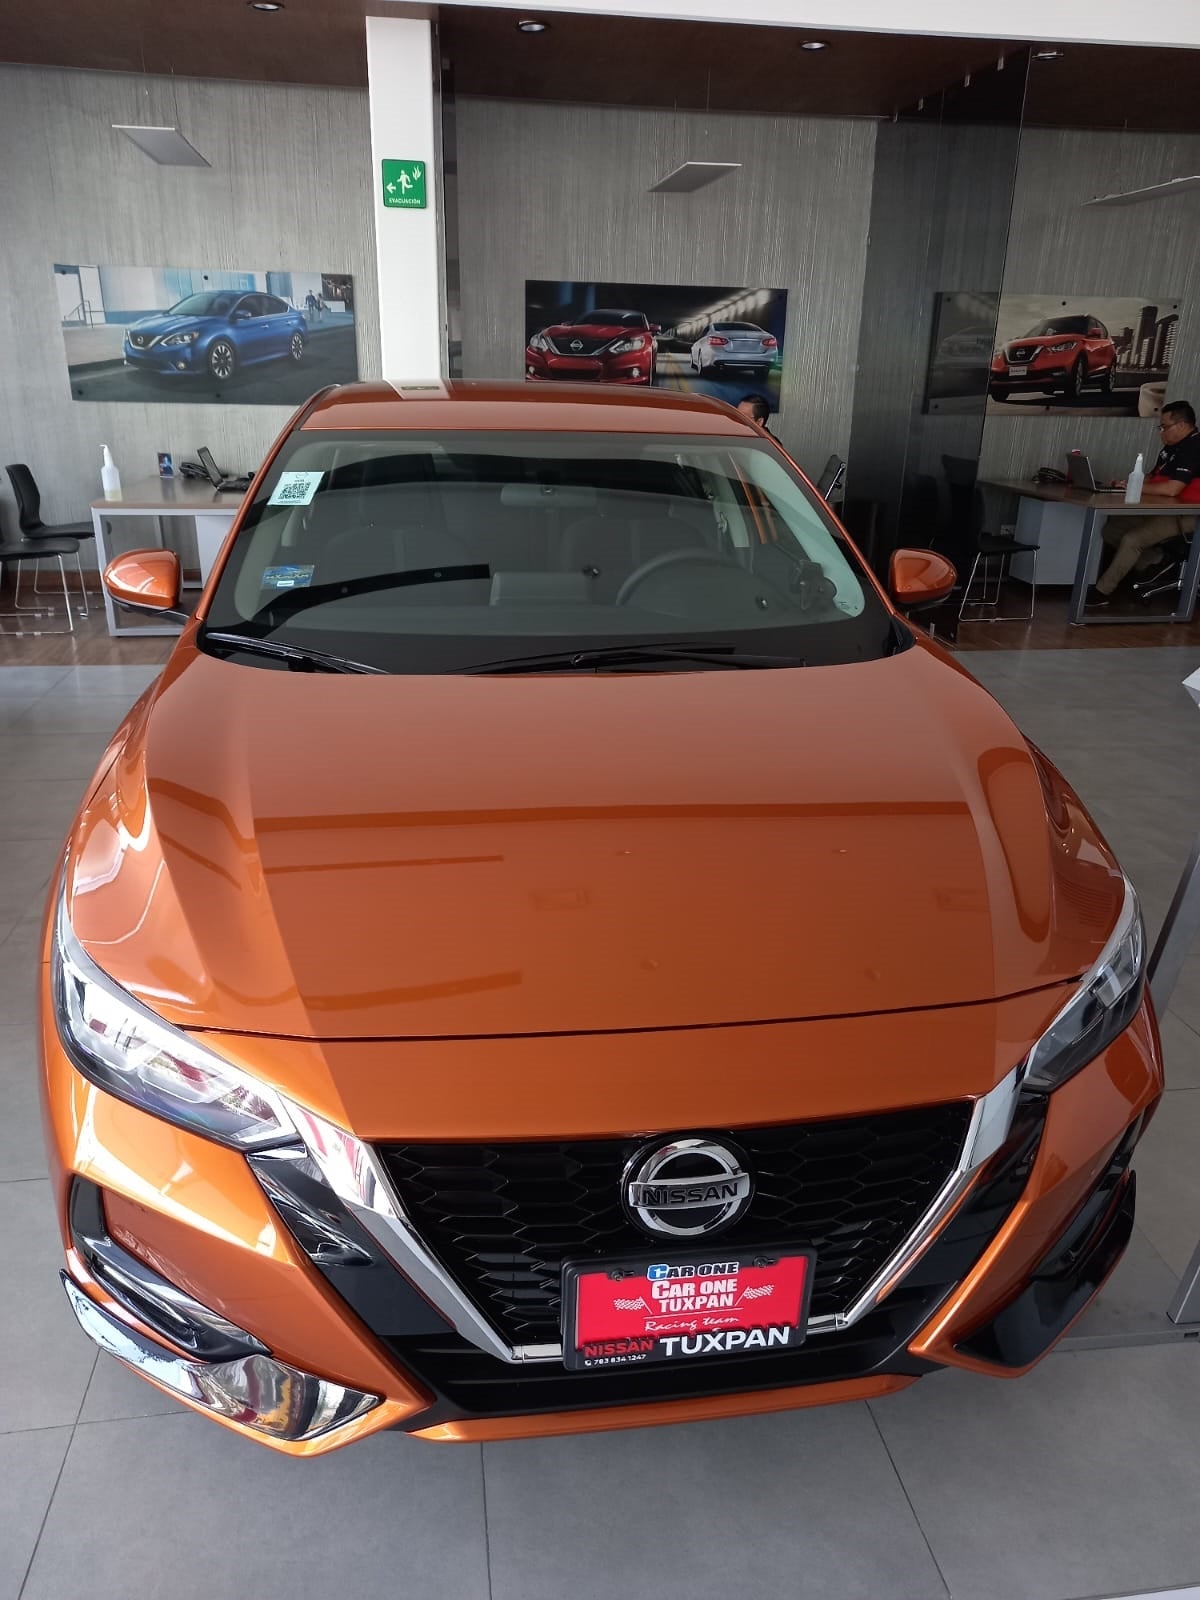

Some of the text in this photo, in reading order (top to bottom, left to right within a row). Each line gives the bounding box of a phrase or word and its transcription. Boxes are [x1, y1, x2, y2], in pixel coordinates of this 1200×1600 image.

[642, 1182, 739, 1206] NISSAN
[647, 1262, 740, 1281] CAR ONE
[652, 1279, 738, 1299] CAR ONE
[659, 1293, 734, 1312] TUXPAN
[645, 1316, 740, 1331] Racing team
[584, 1326, 790, 1357] NISSAN TUXPAN
